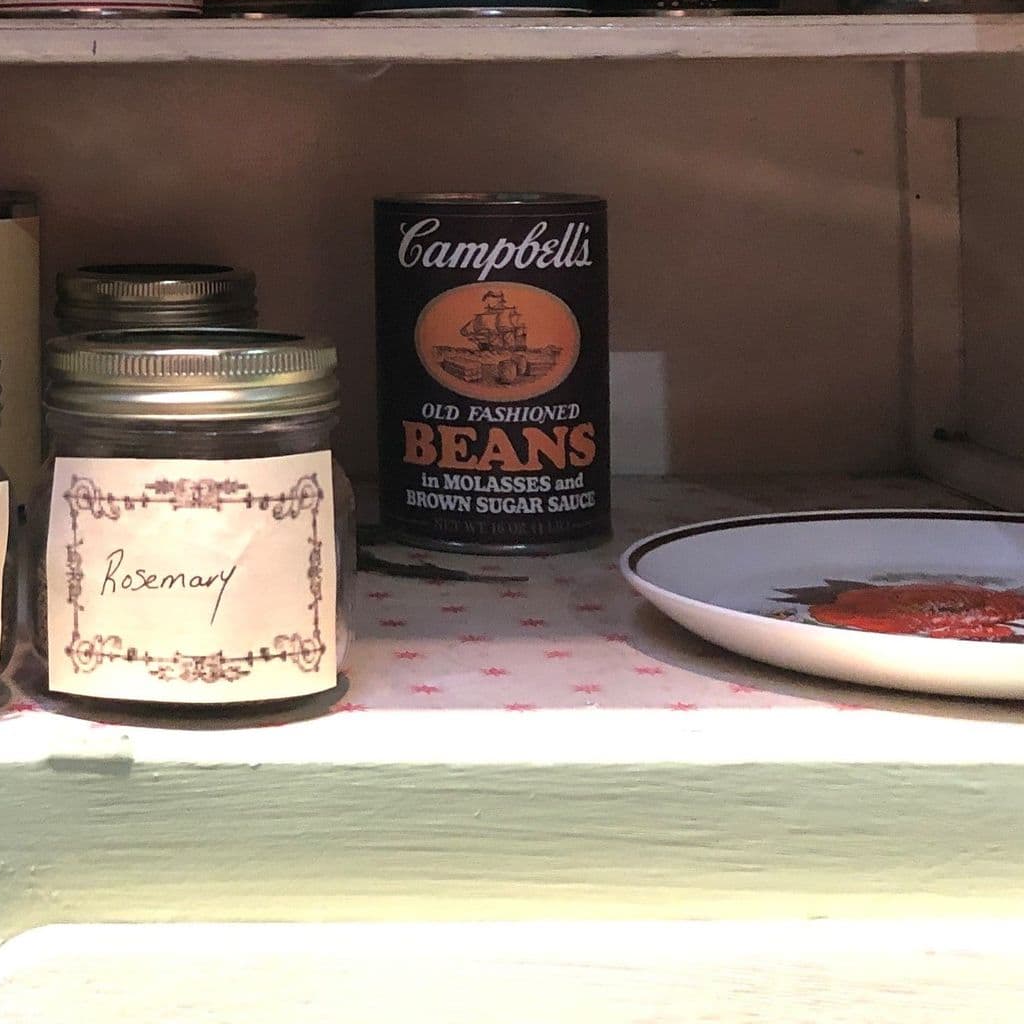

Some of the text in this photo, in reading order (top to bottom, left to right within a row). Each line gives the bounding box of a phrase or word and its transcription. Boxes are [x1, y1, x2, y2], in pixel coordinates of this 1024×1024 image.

[398, 218, 592, 281] Campbell's
[422, 404, 580, 424] OLD FASHIONED
[402, 420, 596, 472] BEANS
[422, 472, 584, 493] in MOLASSES and
[406, 490, 596, 514] BROWN SUGAR SAUCE
[100, 548, 237, 625] Rosemary
